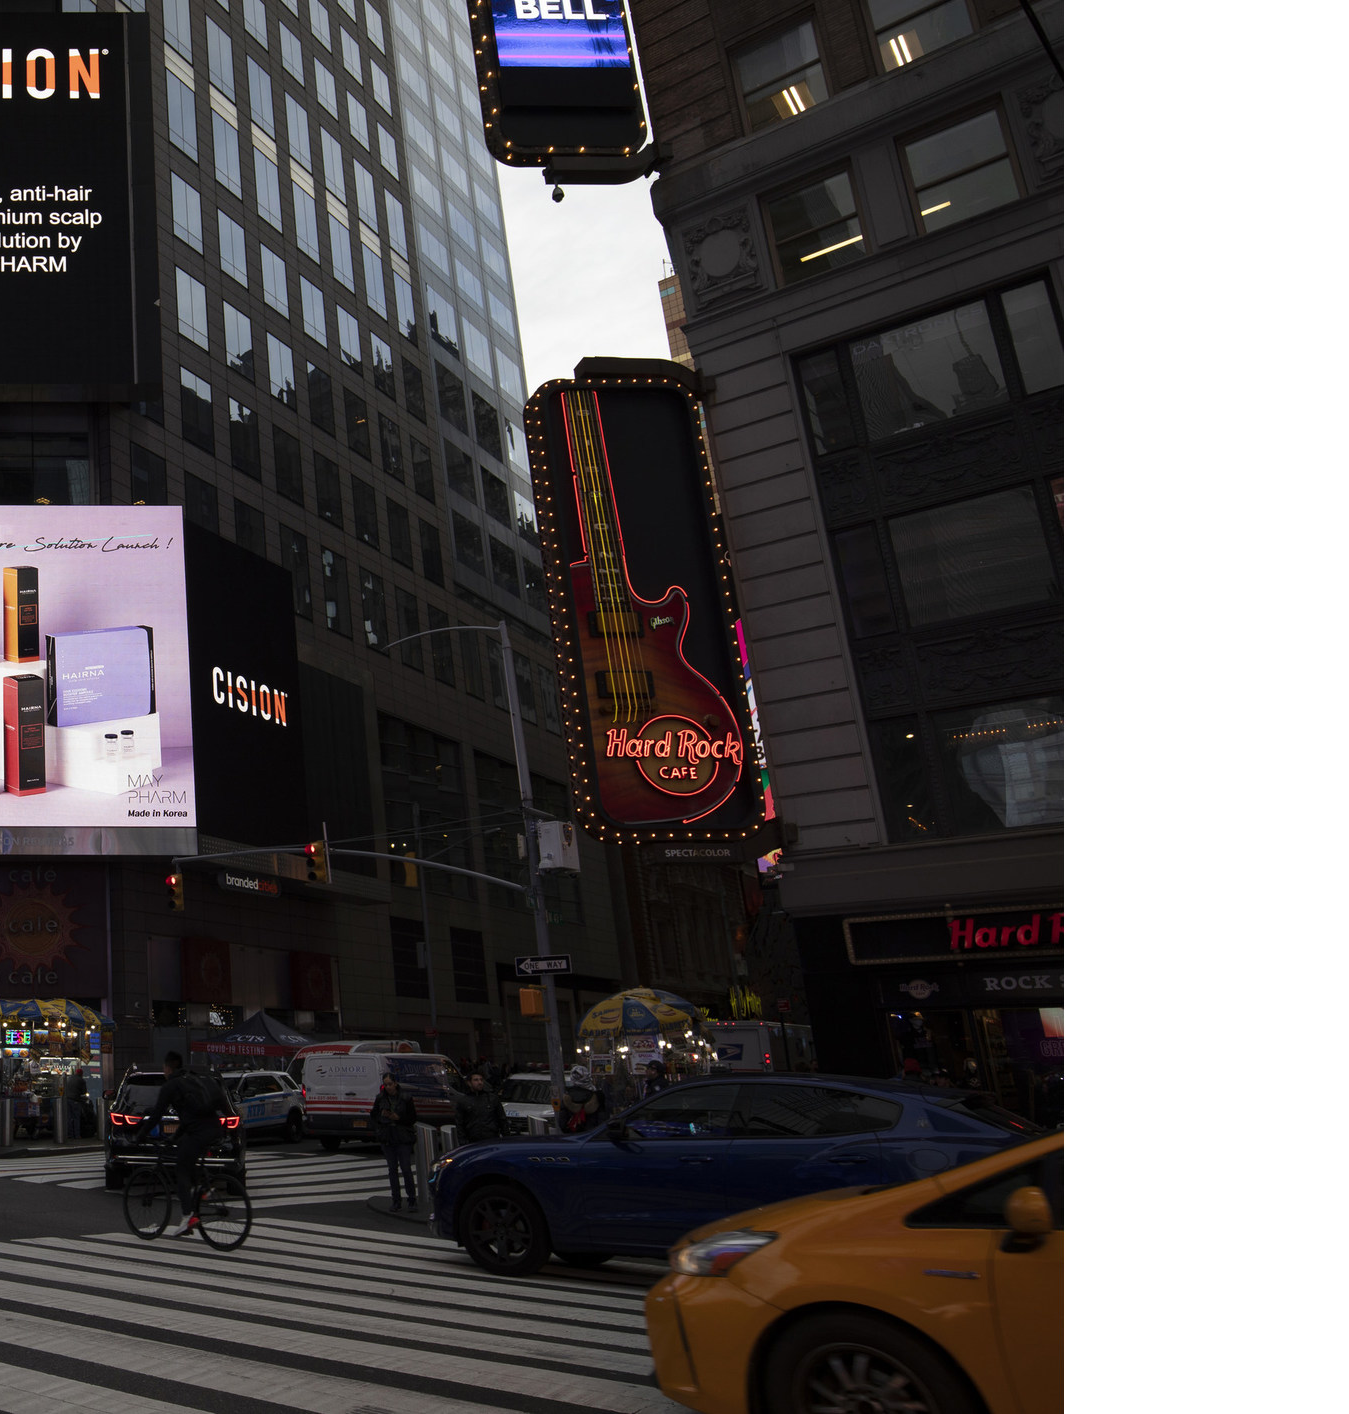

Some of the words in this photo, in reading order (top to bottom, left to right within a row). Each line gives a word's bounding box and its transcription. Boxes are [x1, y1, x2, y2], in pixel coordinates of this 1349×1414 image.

[514, 0, 608, 20] BELL
[10, 185, 92, 201] anti-hair
[49, 209, 102, 228] scalp
[58, 232, 82, 252] by
[24, 537, 97, 552] Solution
[101, 536, 159, 553] Launch
[62, 669, 105, 680] HAIRNA
[212, 667, 288, 727] CISION
[606, 729, 672, 758] Hard
[677, 729, 742, 765] Rock
[128, 775, 163, 787] MAY
[659, 766, 699, 780] CAFE
[128, 791, 187, 804] PHARM
[665, 849, 731, 858] SPECTACOLOR
[948, 914, 1041, 950] Hard
[524, 961, 540, 971] ONE
[546, 959, 564, 969] WAY
[983, 975, 1053, 991] ROCK
[207, 1044, 235, 1054] COVID-19
[238, 1045, 265, 1055] TESTING
[248, 1103, 265, 1118] NYPD
